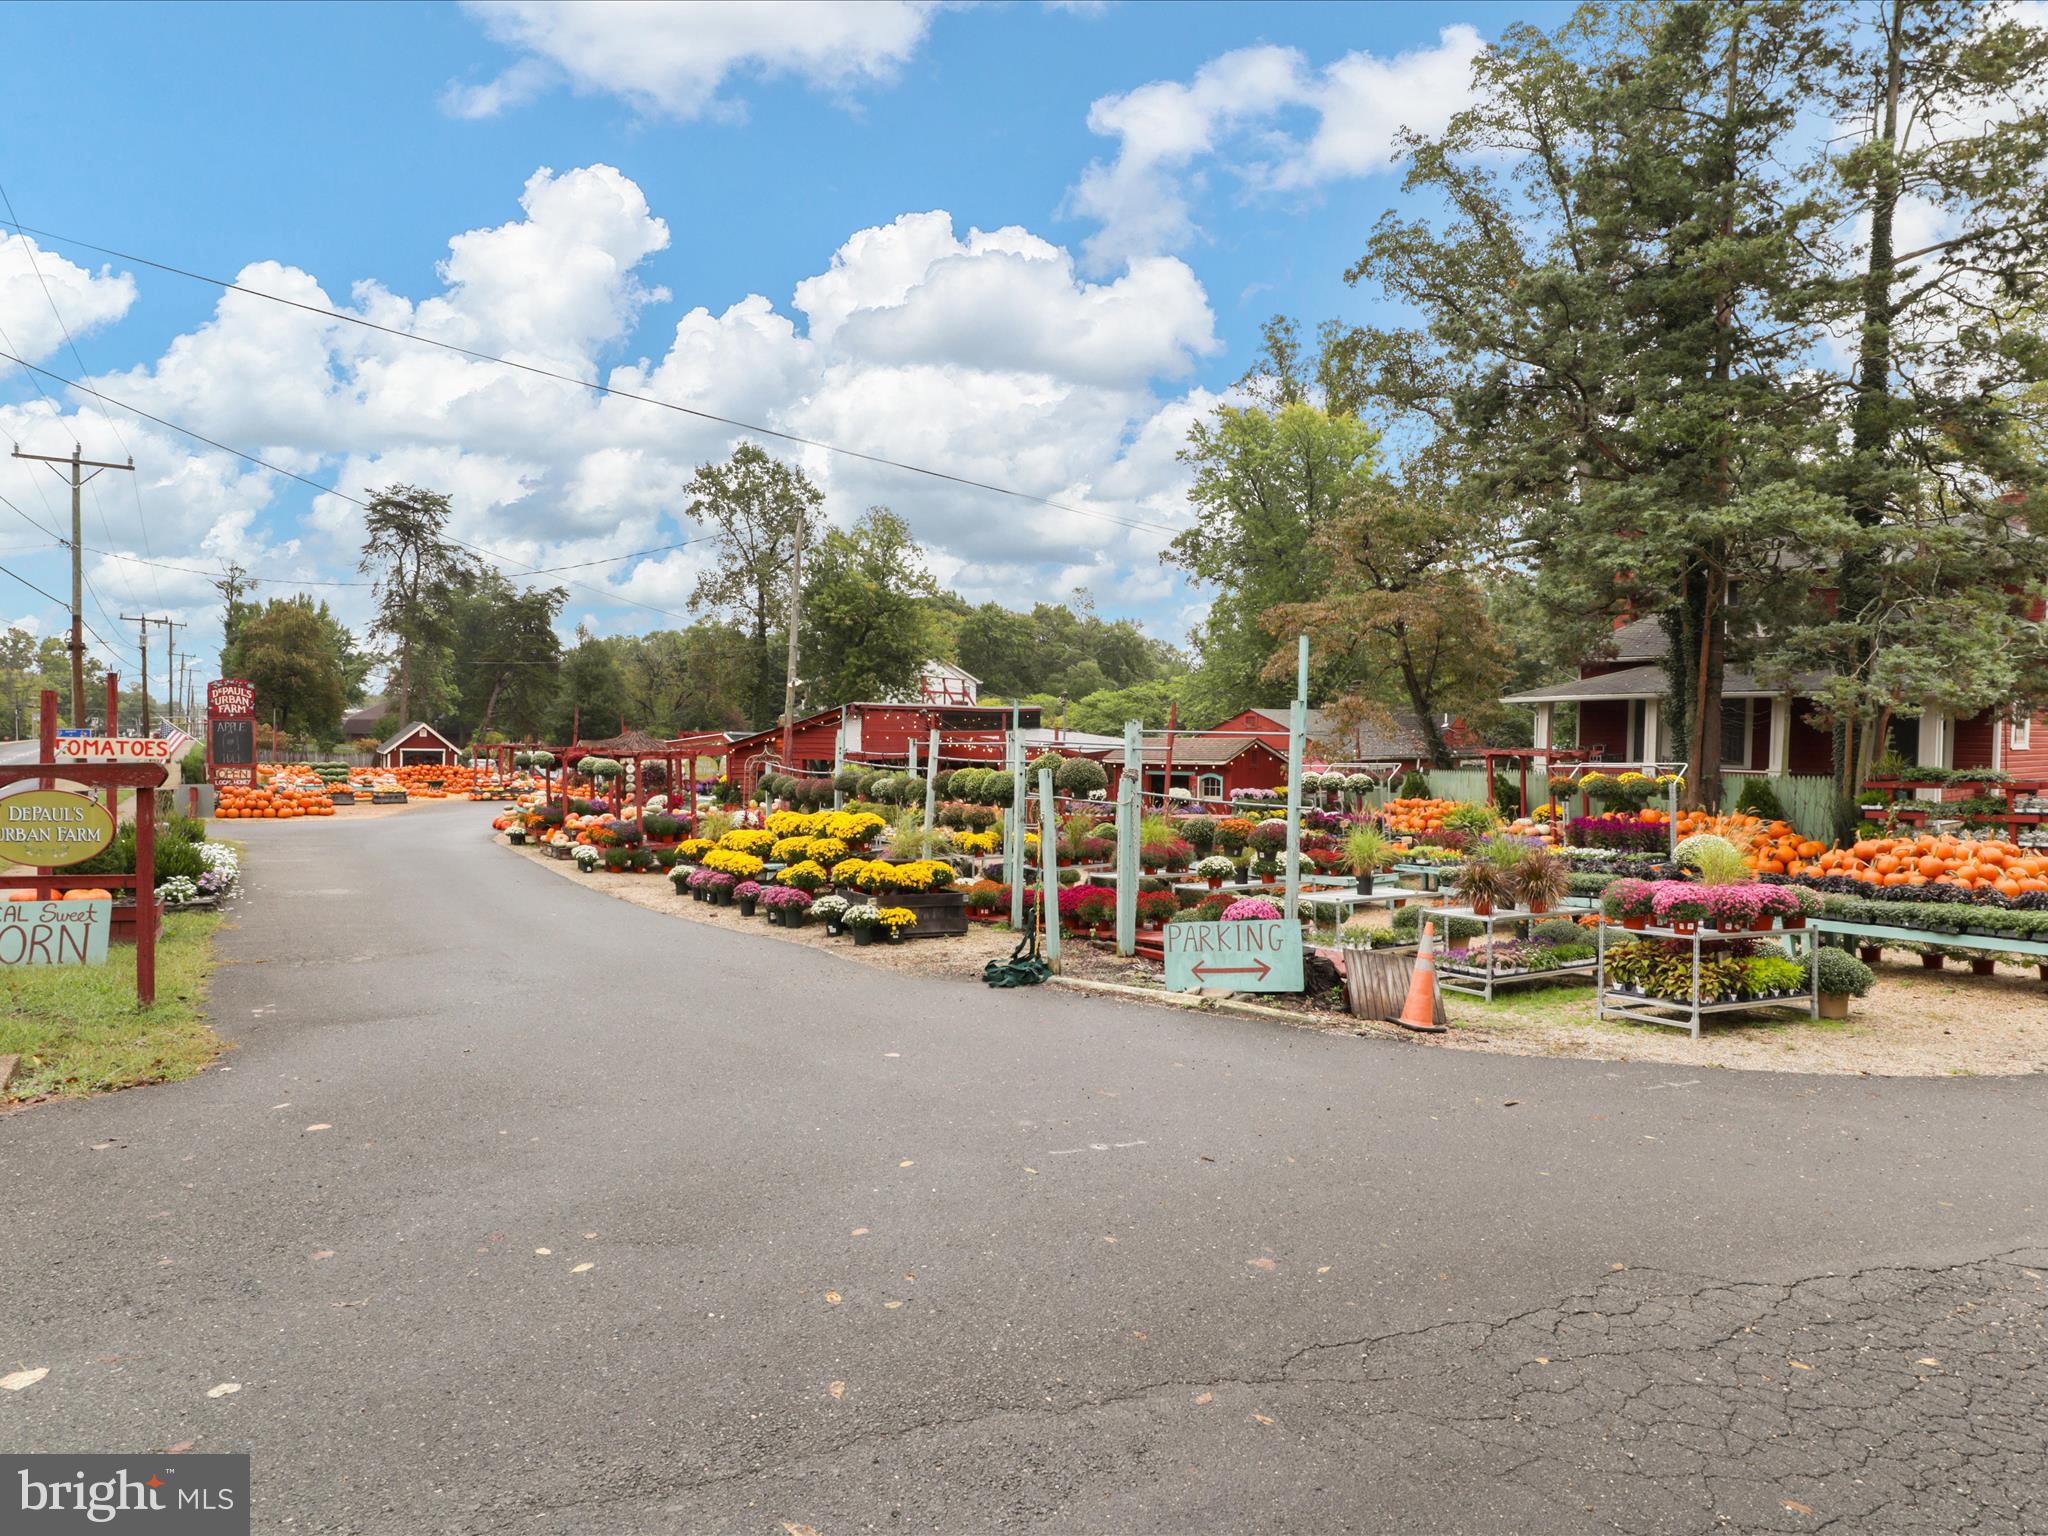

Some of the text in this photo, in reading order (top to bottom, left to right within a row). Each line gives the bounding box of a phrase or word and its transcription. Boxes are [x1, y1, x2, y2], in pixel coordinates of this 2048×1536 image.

[214, 695, 249, 707] URBAN
[218, 704, 247, 713] FARM
[54, 738, 168, 757] TOMATOES
[218, 769, 248, 779] OPEN
[57, 826, 100, 842] FARM
[0, 903, 98, 923] AL Sweet
[0, 923, 91, 966] ORN
[1168, 923, 1284, 952] PARKING
